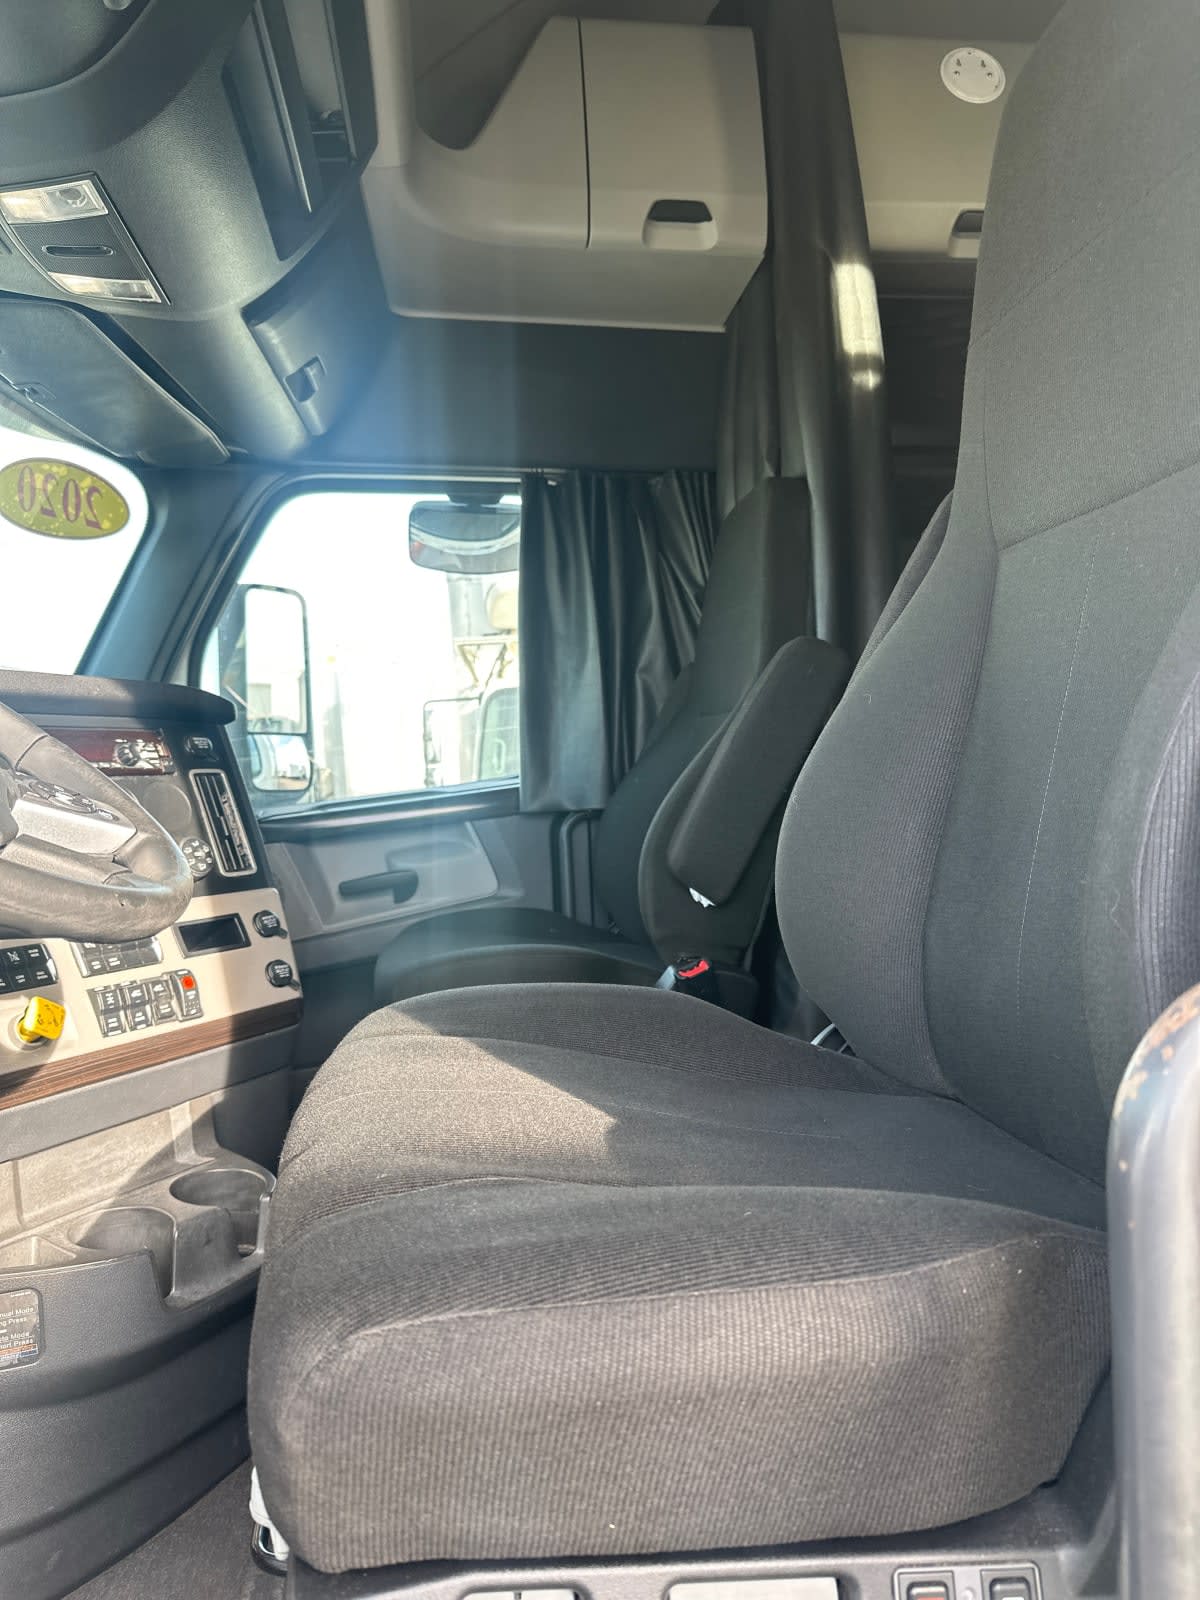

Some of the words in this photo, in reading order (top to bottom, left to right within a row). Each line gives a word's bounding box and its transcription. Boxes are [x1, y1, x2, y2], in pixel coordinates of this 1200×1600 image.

[15, 1306, 34, 1315] Mode
[8, 1316, 27, 1325] Press
[13, 1338, 34, 1347] Press
